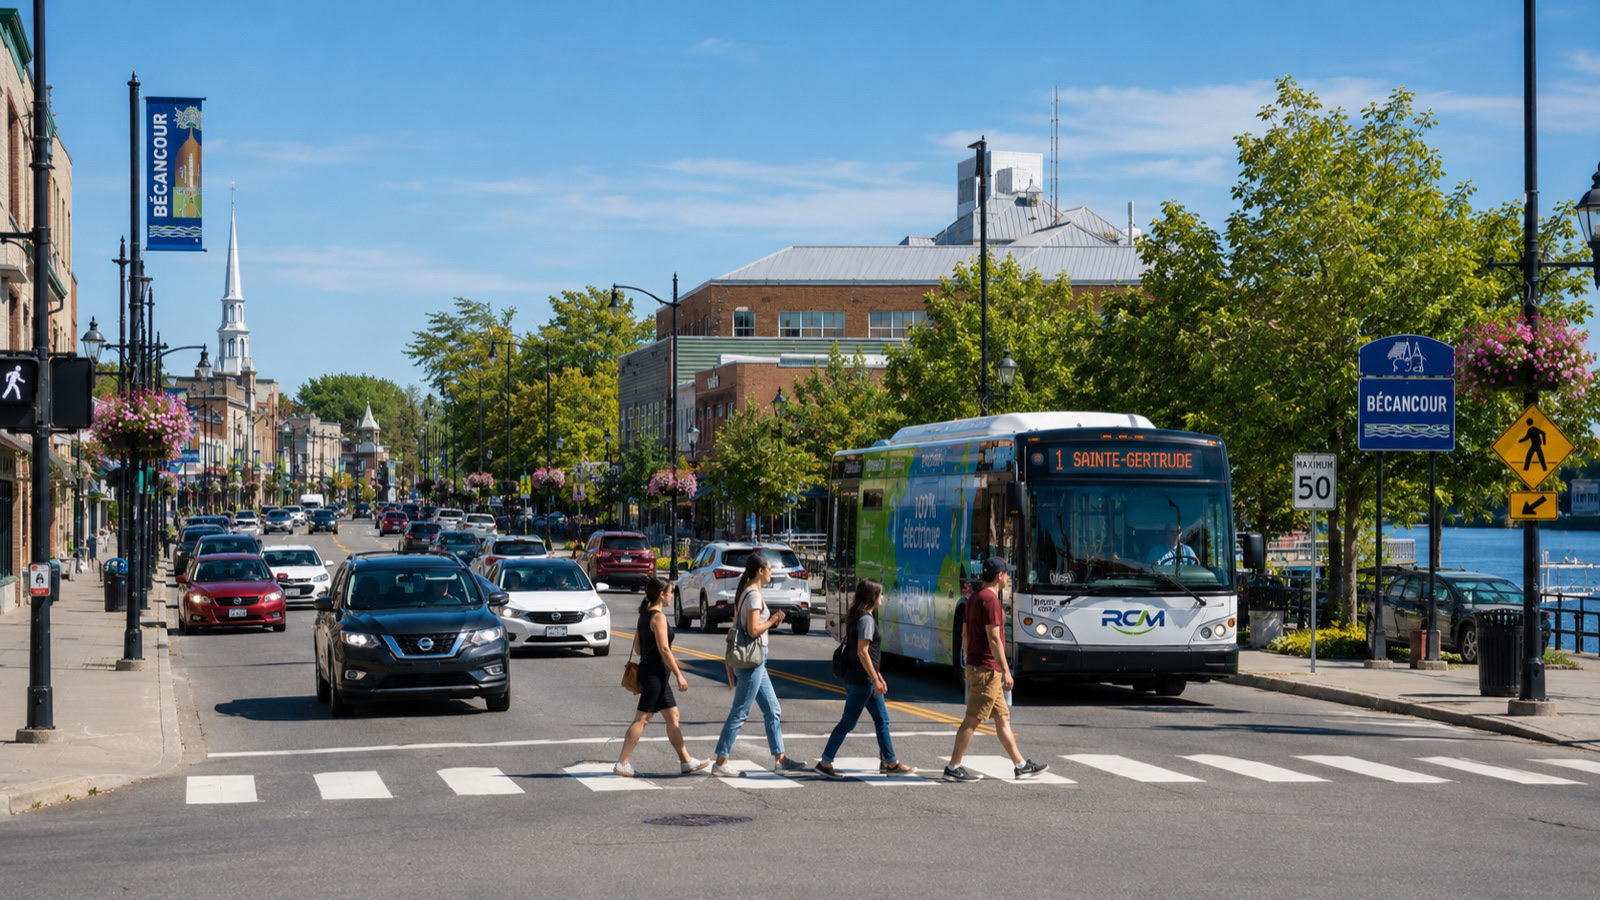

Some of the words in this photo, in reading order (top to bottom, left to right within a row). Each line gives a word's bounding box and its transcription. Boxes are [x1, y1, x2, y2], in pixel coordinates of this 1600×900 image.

[149, 113, 168, 217] BÉCANCOUR
[1366, 391, 1447, 413] BÉCANCOUR
[1055, 449, 1063, 471] 1
[1073, 451, 1193, 469] SAINTE-GERTRUDE
[1296, 460, 1333, 470] MAXIMUM
[1298, 475, 1331, 500] 50
[1101, 609, 1165, 627] RCM
